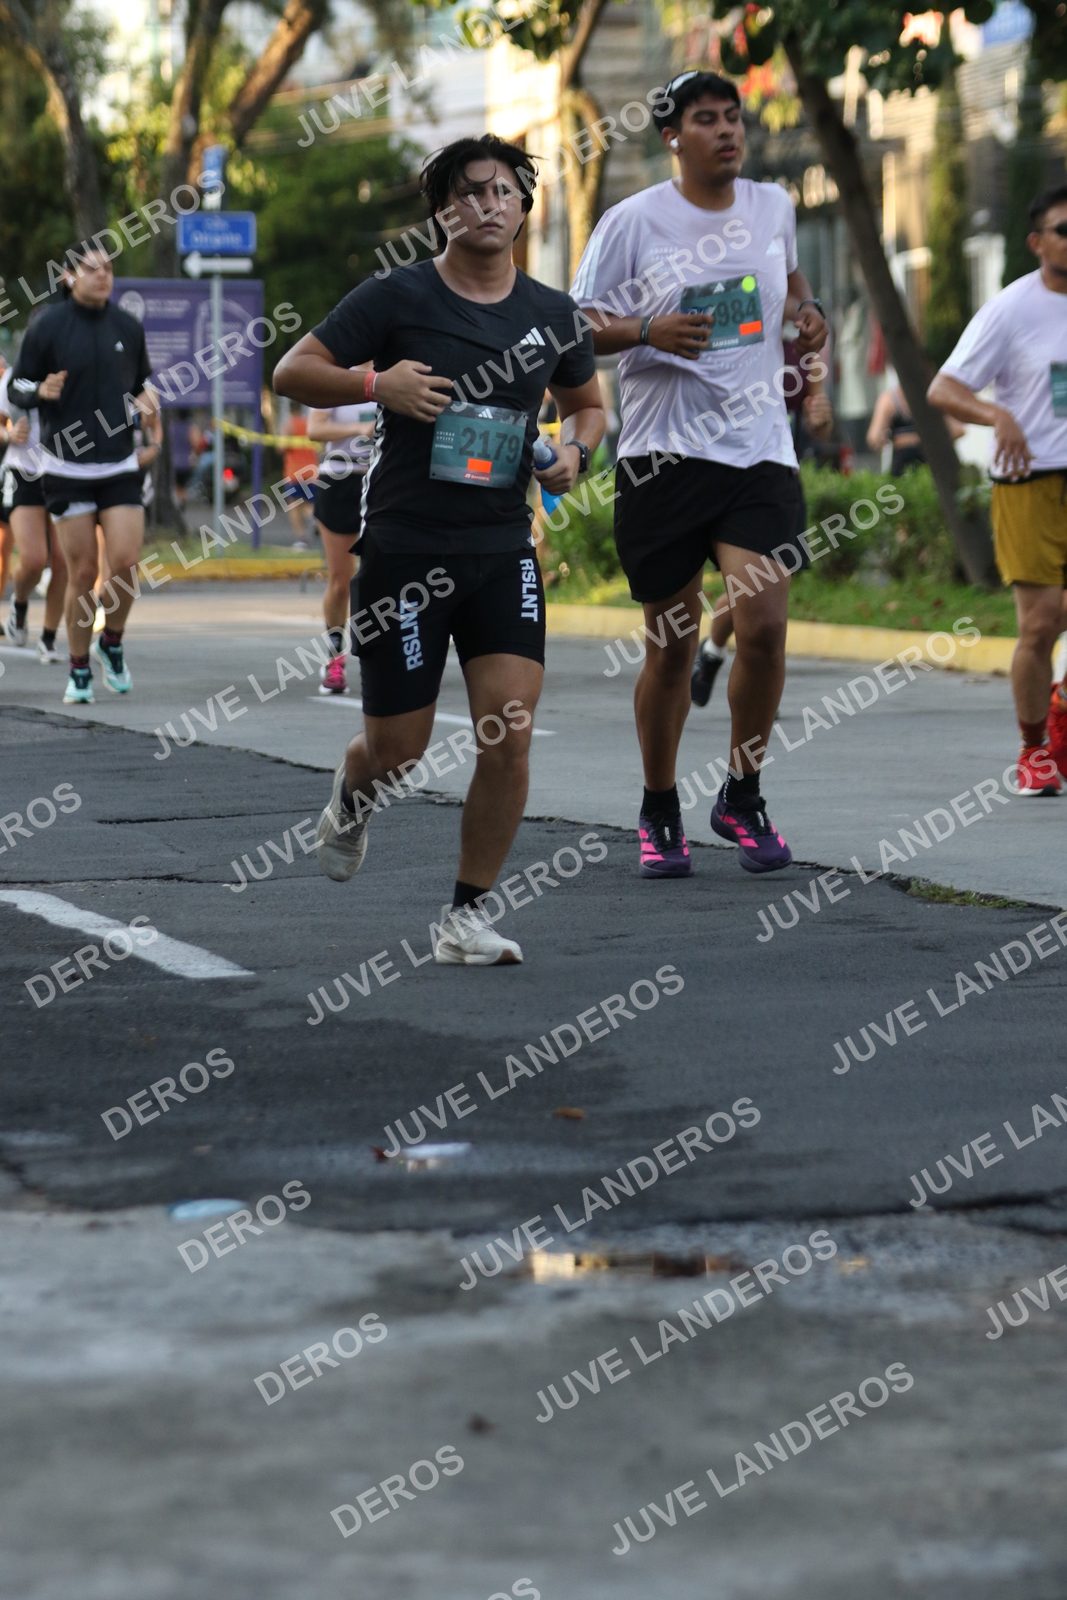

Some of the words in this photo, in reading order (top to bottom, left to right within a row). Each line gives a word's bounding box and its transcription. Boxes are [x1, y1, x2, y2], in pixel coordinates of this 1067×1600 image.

[459, 426, 520, 464] 2179
[519, 558, 539, 622] RSLNT
[399, 600, 424, 671] RSLNT
